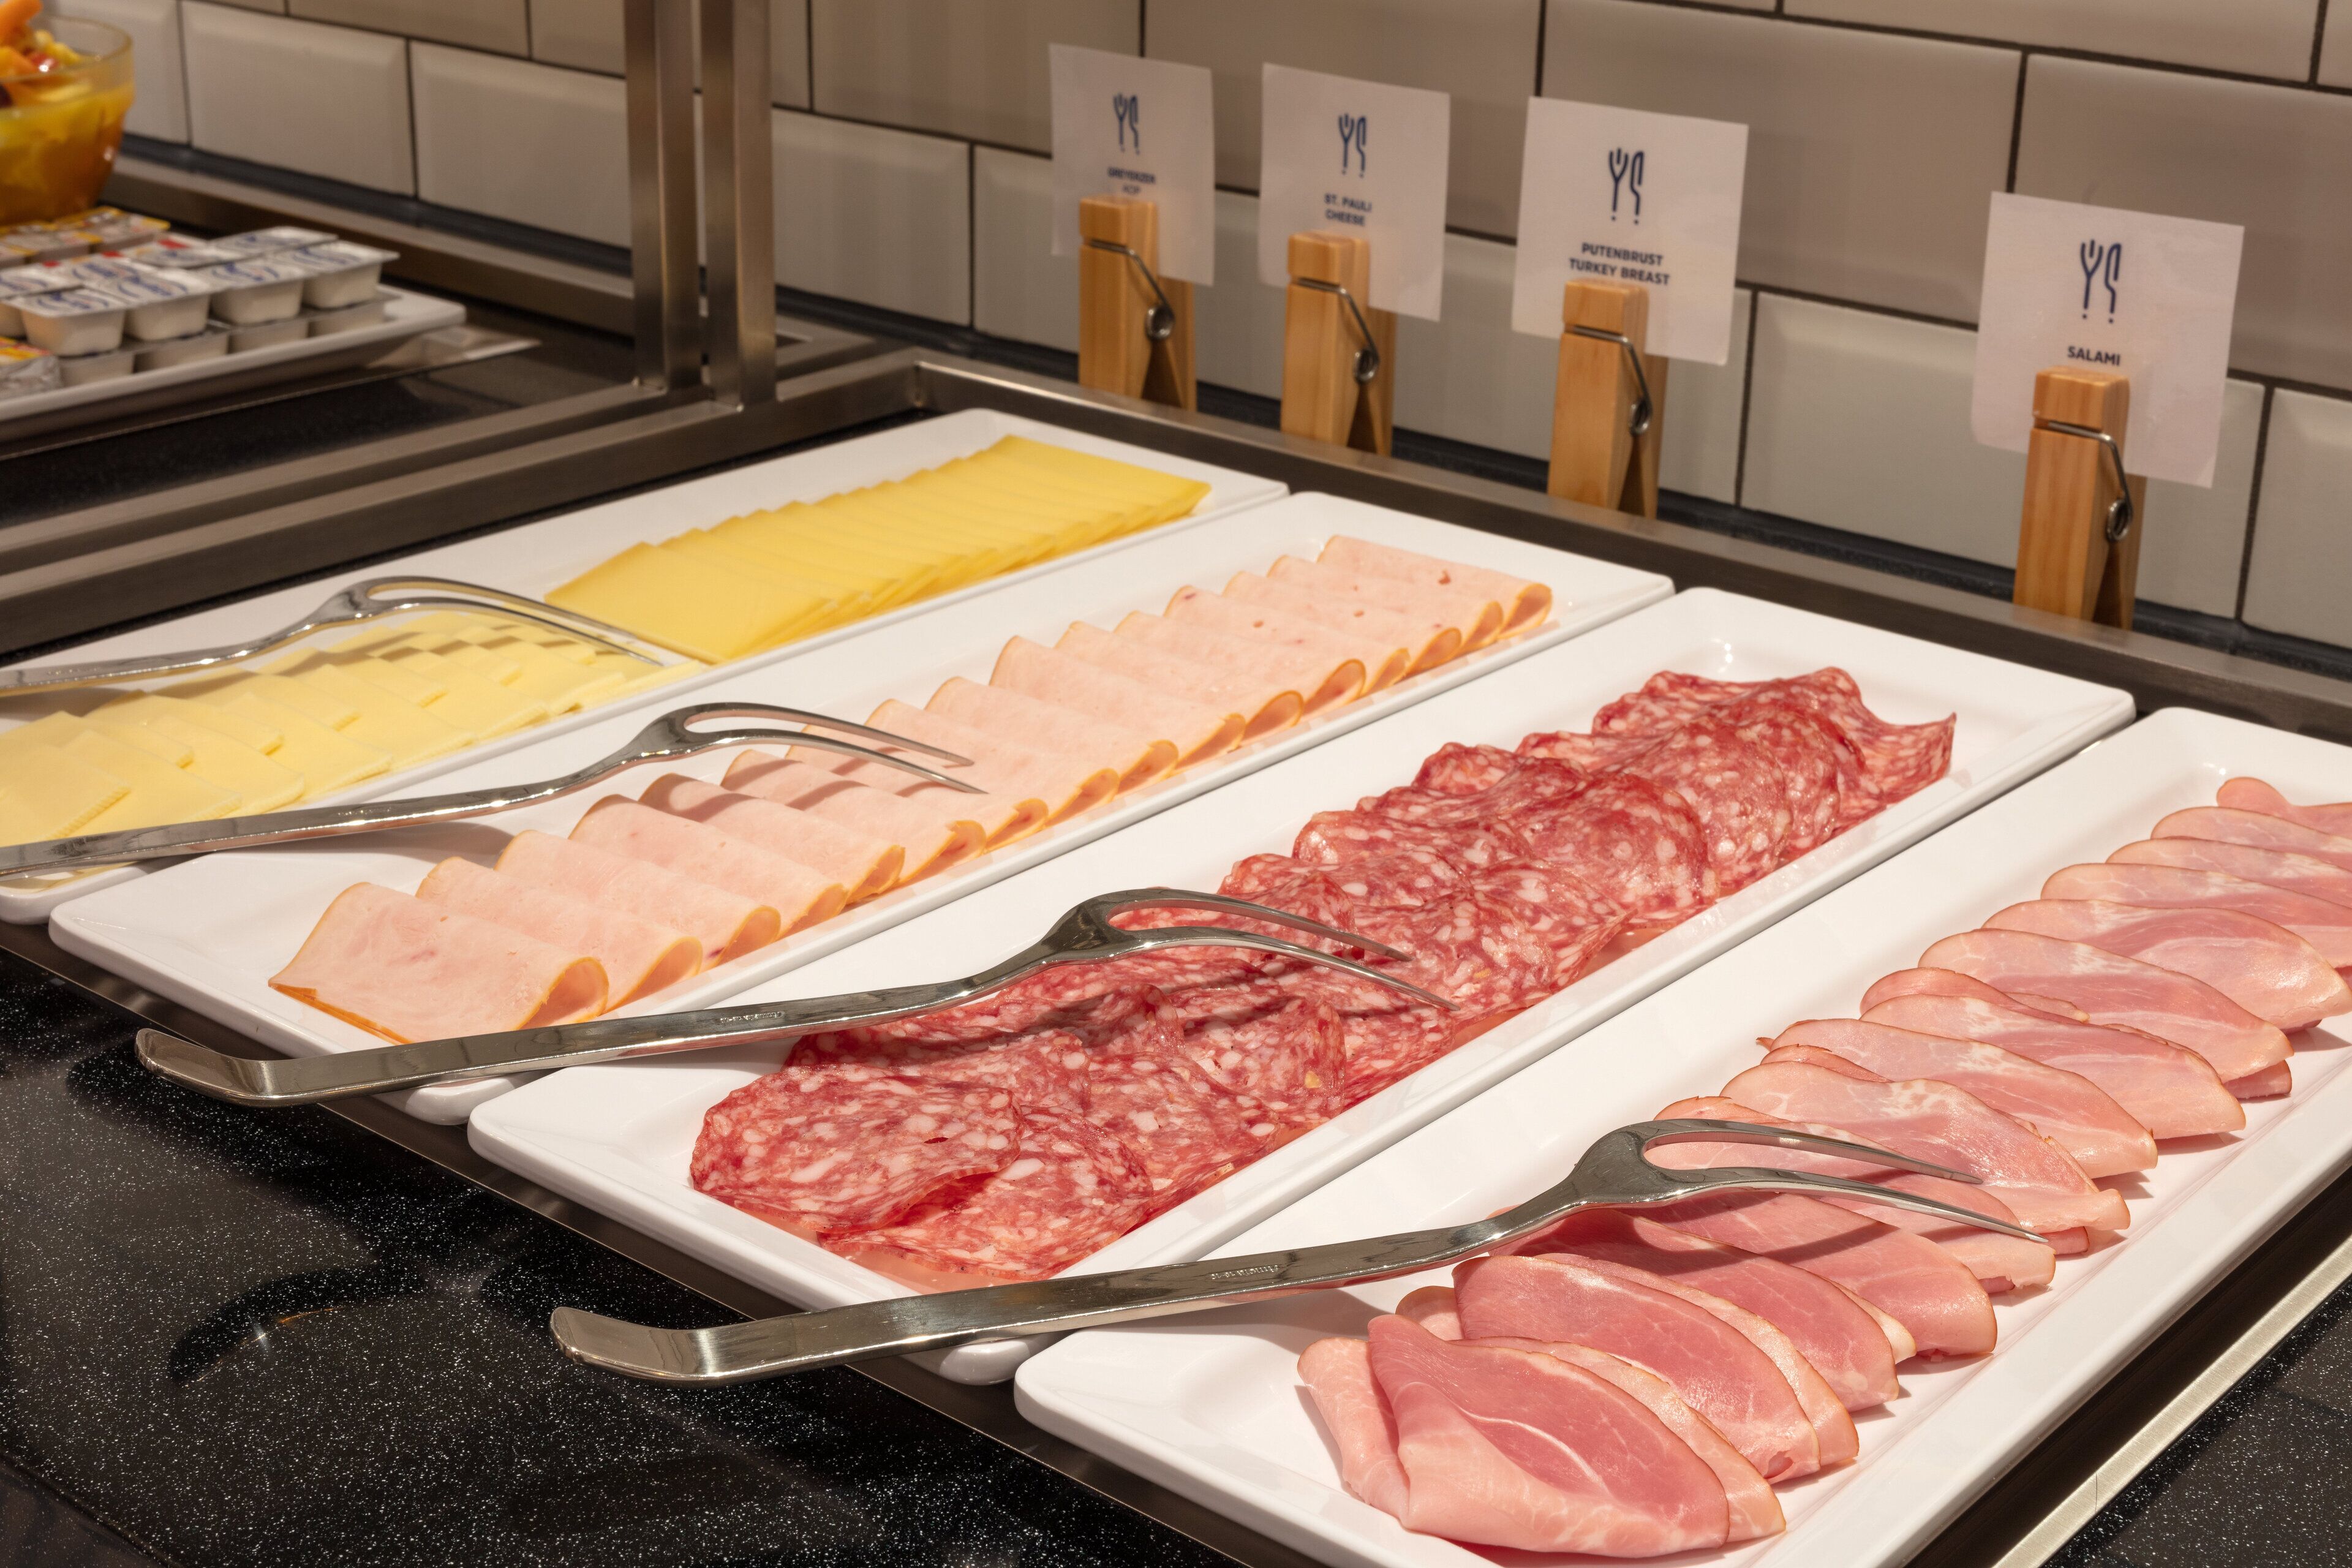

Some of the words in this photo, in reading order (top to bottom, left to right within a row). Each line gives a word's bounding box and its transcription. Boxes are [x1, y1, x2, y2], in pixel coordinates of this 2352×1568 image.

[1324, 193, 1339, 205] ST.
[1341, 197, 1373, 212] PAULI
[1325, 209, 1365, 226] CHEESE
[1581, 242, 1663, 266] PUTENBRUST
[1569, 257, 1617, 276] TURKEY
[1620, 266, 1670, 285] BREAST
[2068, 345, 2120, 366] SALAMI
